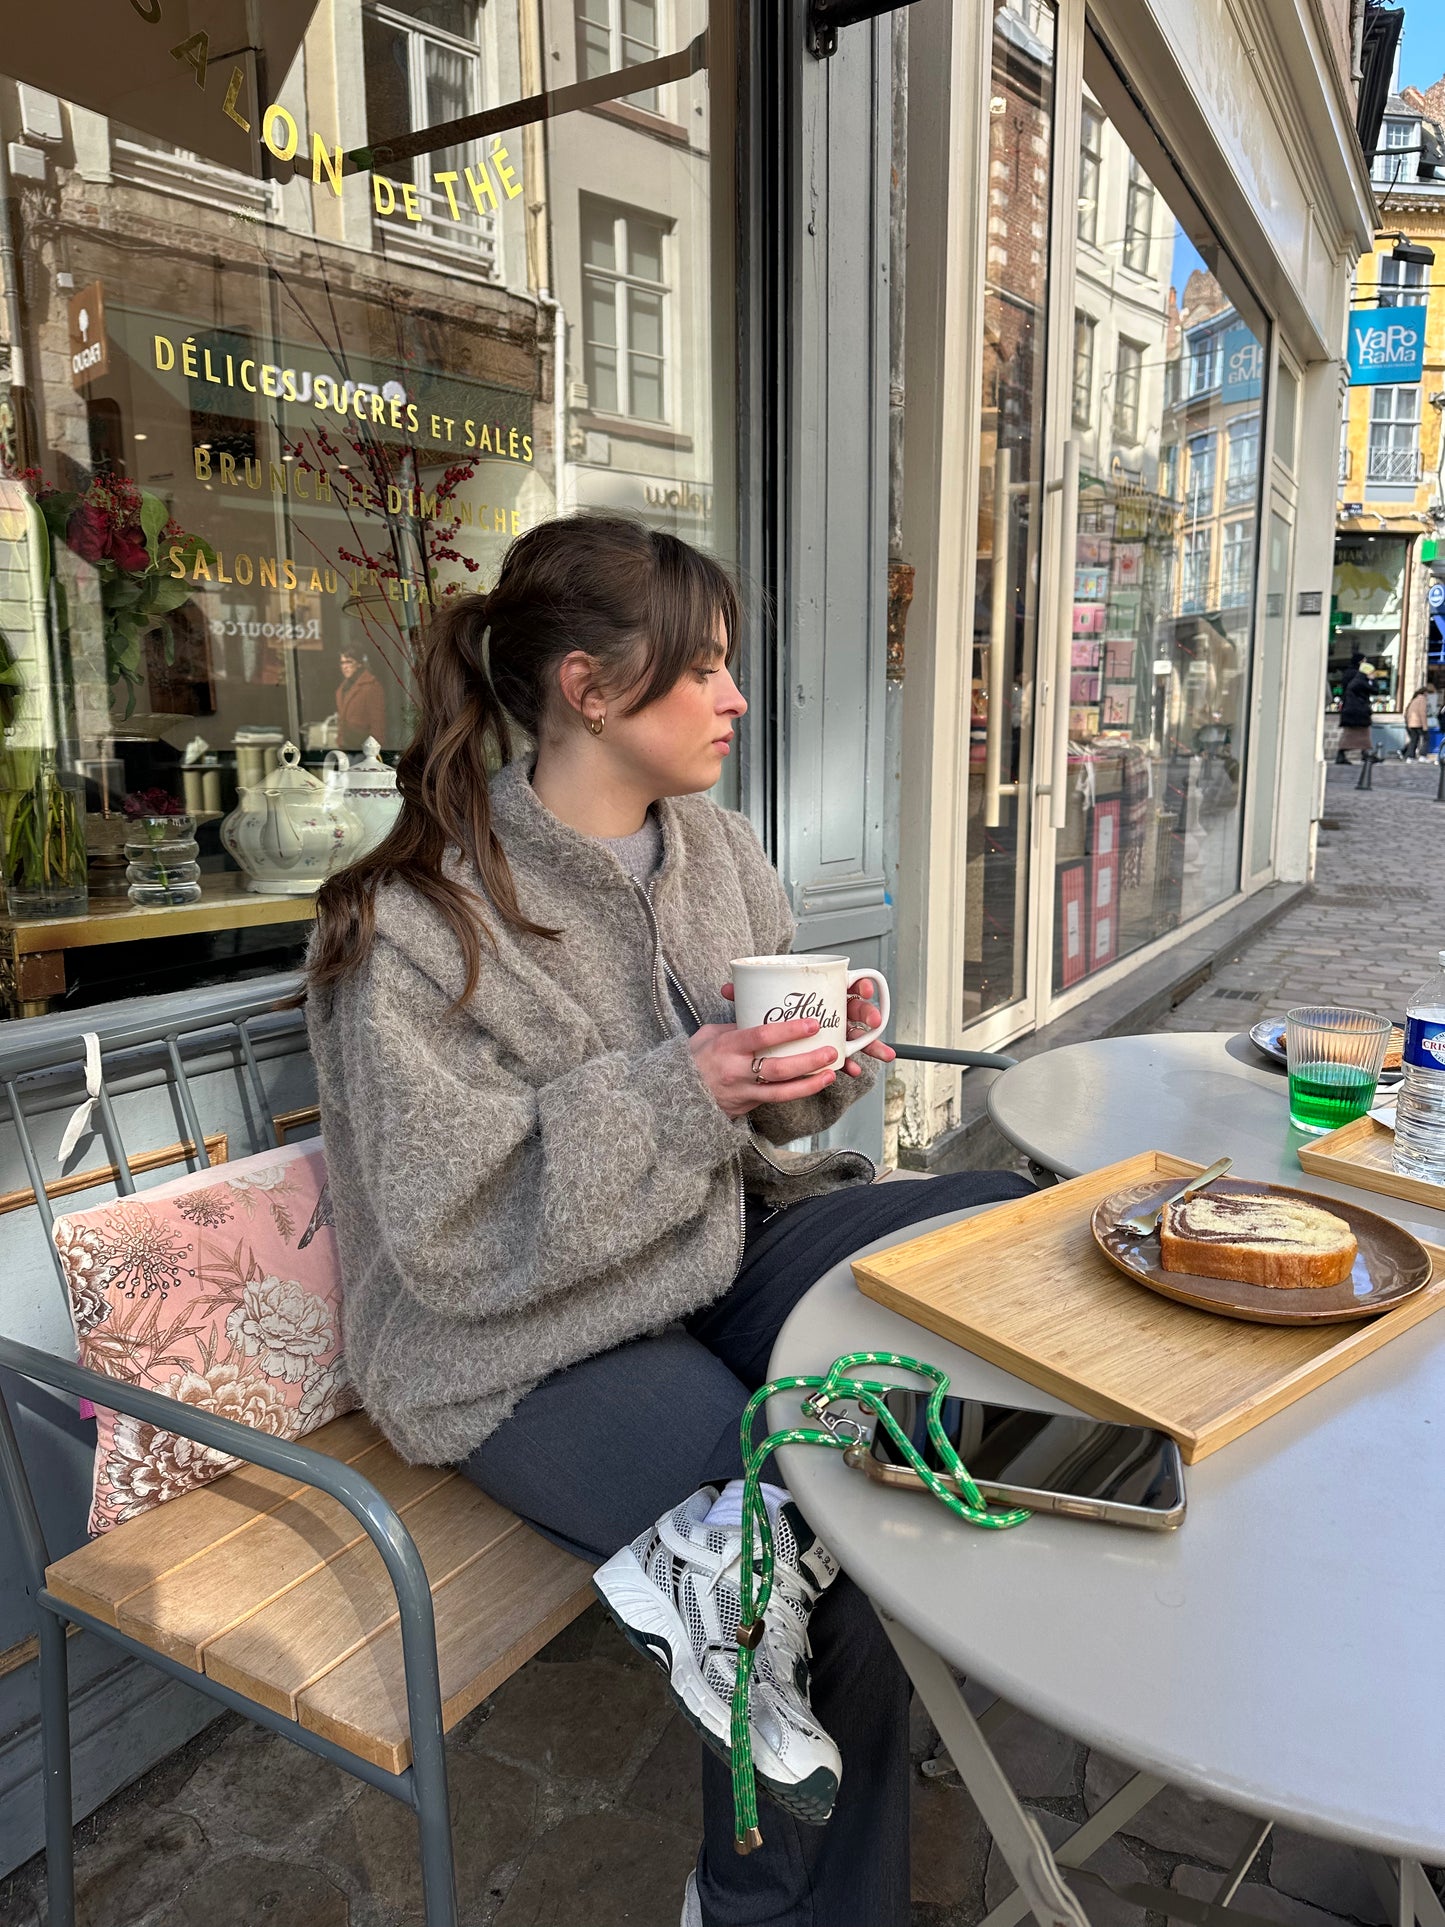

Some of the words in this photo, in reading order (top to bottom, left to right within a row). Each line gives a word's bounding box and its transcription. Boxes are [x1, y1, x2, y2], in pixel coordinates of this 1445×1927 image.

[373, 175, 422, 221] DE
[434, 138, 523, 221] THÉ
[154, 335, 297, 402] DÉLICES
[313, 379, 419, 433] SUCRÉS
[431, 414, 455, 441] ET
[464, 419, 533, 462] SALÉS
[194, 447, 332, 502] BRUNCH
[347, 481, 374, 510] LE
[387, 484, 521, 537] DIMANCHE
[169, 545, 297, 590] SALONS
[310, 568, 338, 594] AU
[388, 577, 412, 602] ET
[784, 991, 825, 1019] Hot
